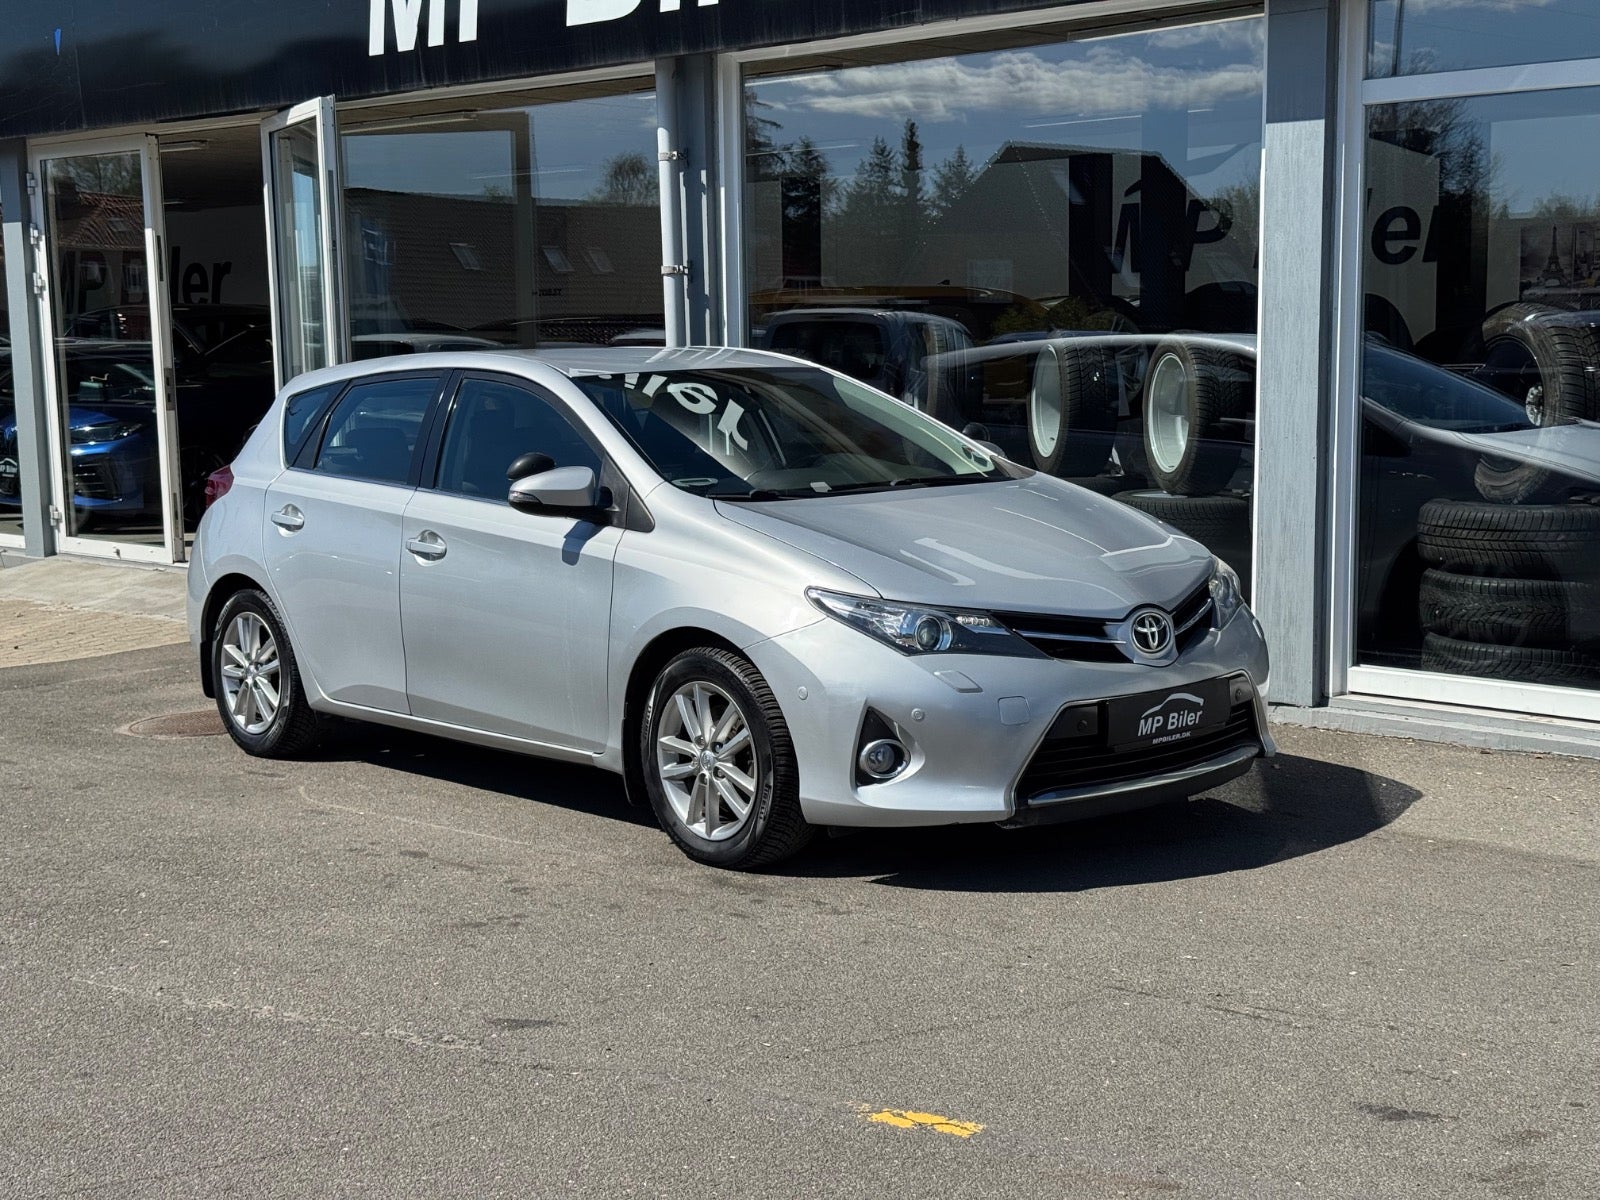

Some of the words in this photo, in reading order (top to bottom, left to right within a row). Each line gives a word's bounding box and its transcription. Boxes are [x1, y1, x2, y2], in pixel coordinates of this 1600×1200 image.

[1137, 716, 1164, 737] MP
[1167, 709, 1203, 730] Biler
[1152, 731, 1192, 745] MPBILER.DK
